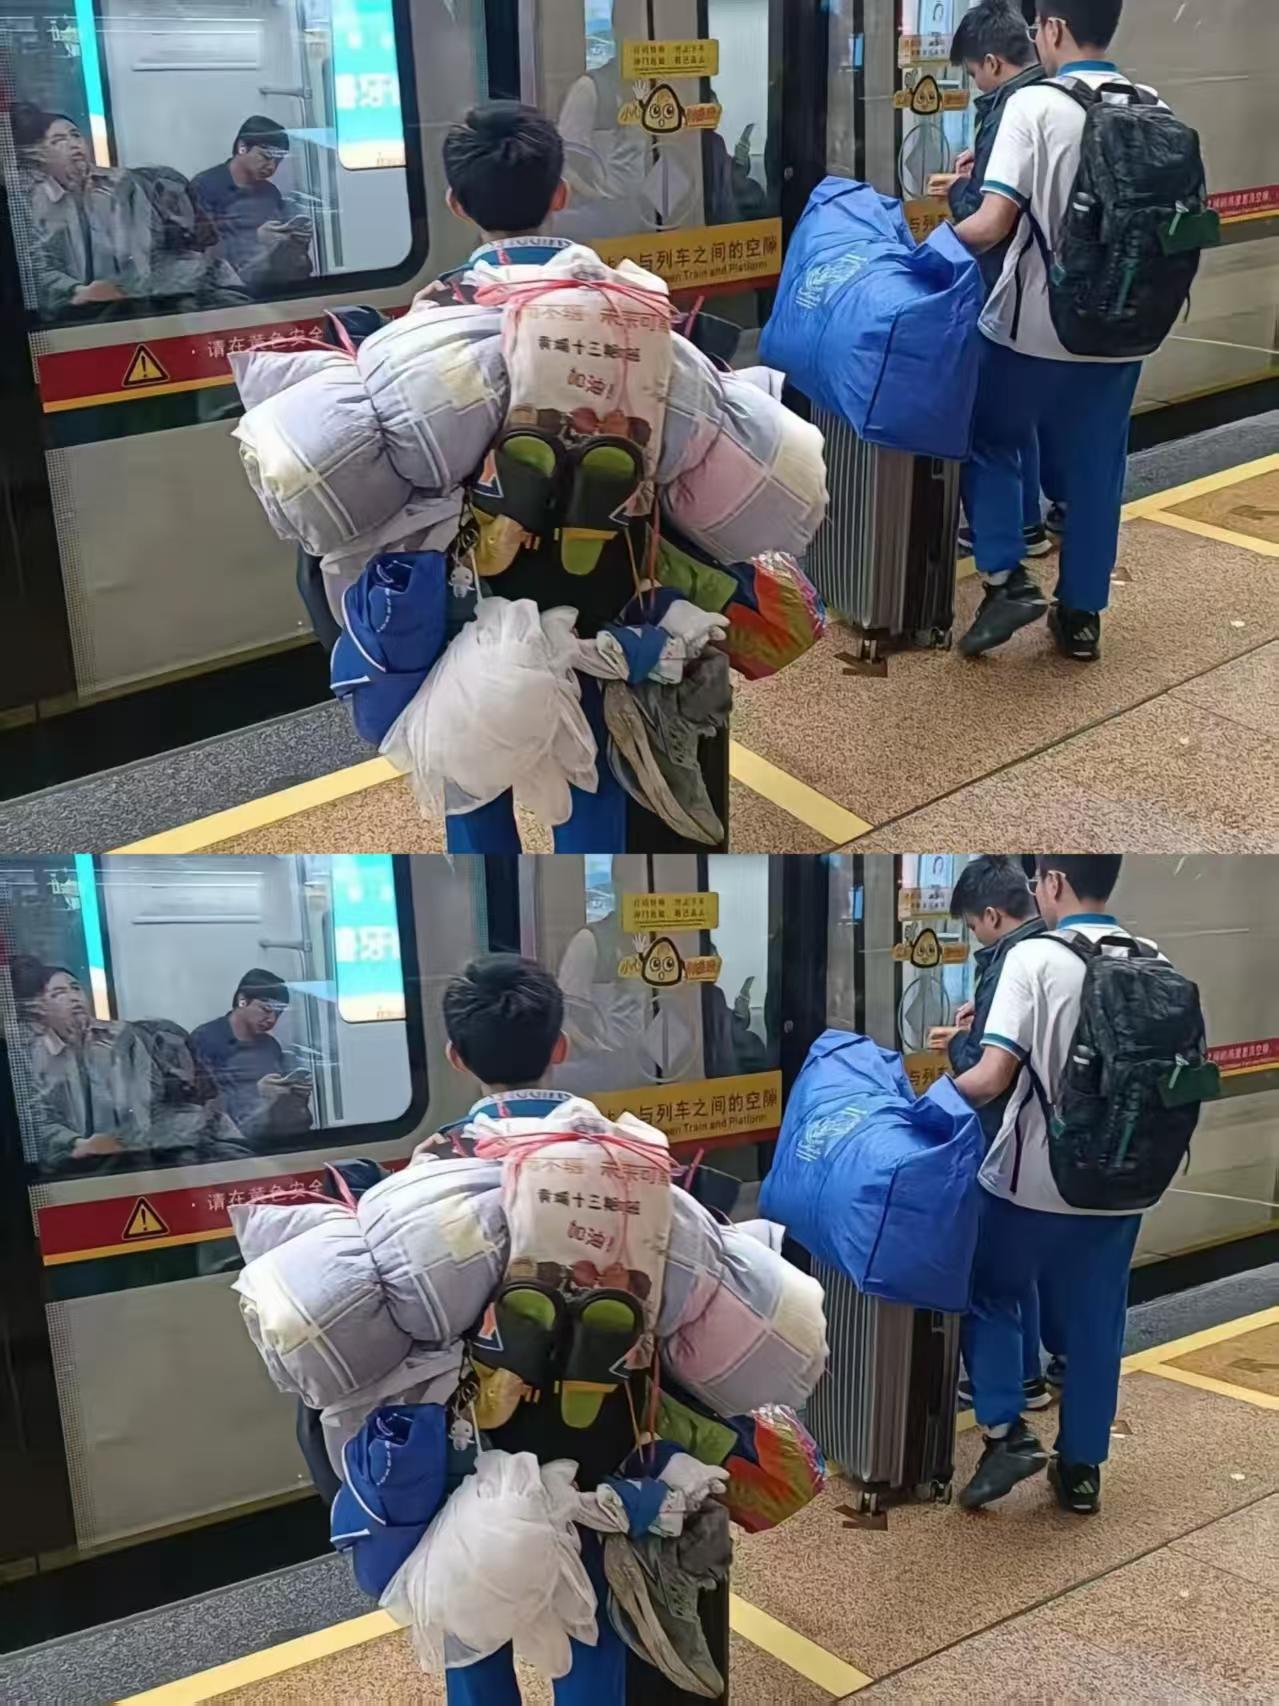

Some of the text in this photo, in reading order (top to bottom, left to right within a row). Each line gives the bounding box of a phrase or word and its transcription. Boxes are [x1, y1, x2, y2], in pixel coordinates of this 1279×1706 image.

[606, 235, 777, 272] 与列车之间的空隙
[684, 269, 708, 279] Train
[709, 266, 727, 276] and
[729, 261, 768, 274] Platform
[606, 1088, 777, 1125] 与列车之间的空隙
[684, 1122, 708, 1132] Train
[709, 1119, 727, 1129] and
[729, 1114, 768, 1127] Platform
